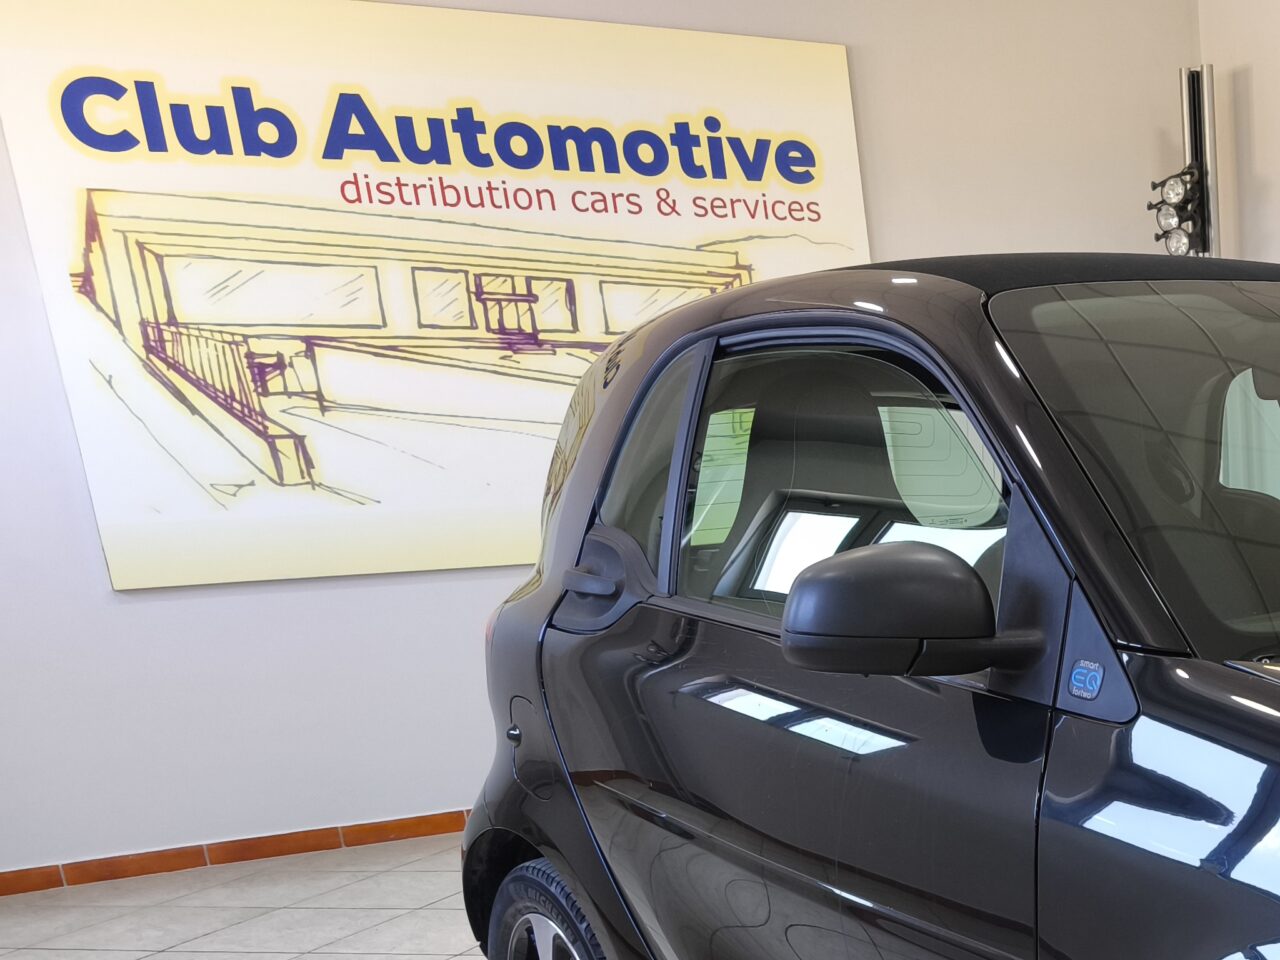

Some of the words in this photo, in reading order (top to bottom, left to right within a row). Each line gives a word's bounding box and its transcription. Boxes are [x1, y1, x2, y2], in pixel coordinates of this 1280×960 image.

[61, 77, 297, 158] Club
[322, 92, 816, 185] Automotive
[340, 174, 556, 212] distribution
[571, 187, 643, 217] cars
[656, 188, 682, 218] &
[692, 193, 823, 223] services
[1080, 660, 1099, 671] smart
[1071, 668, 1101, 690] EQ
[1072, 686, 1092, 699] fortwo
